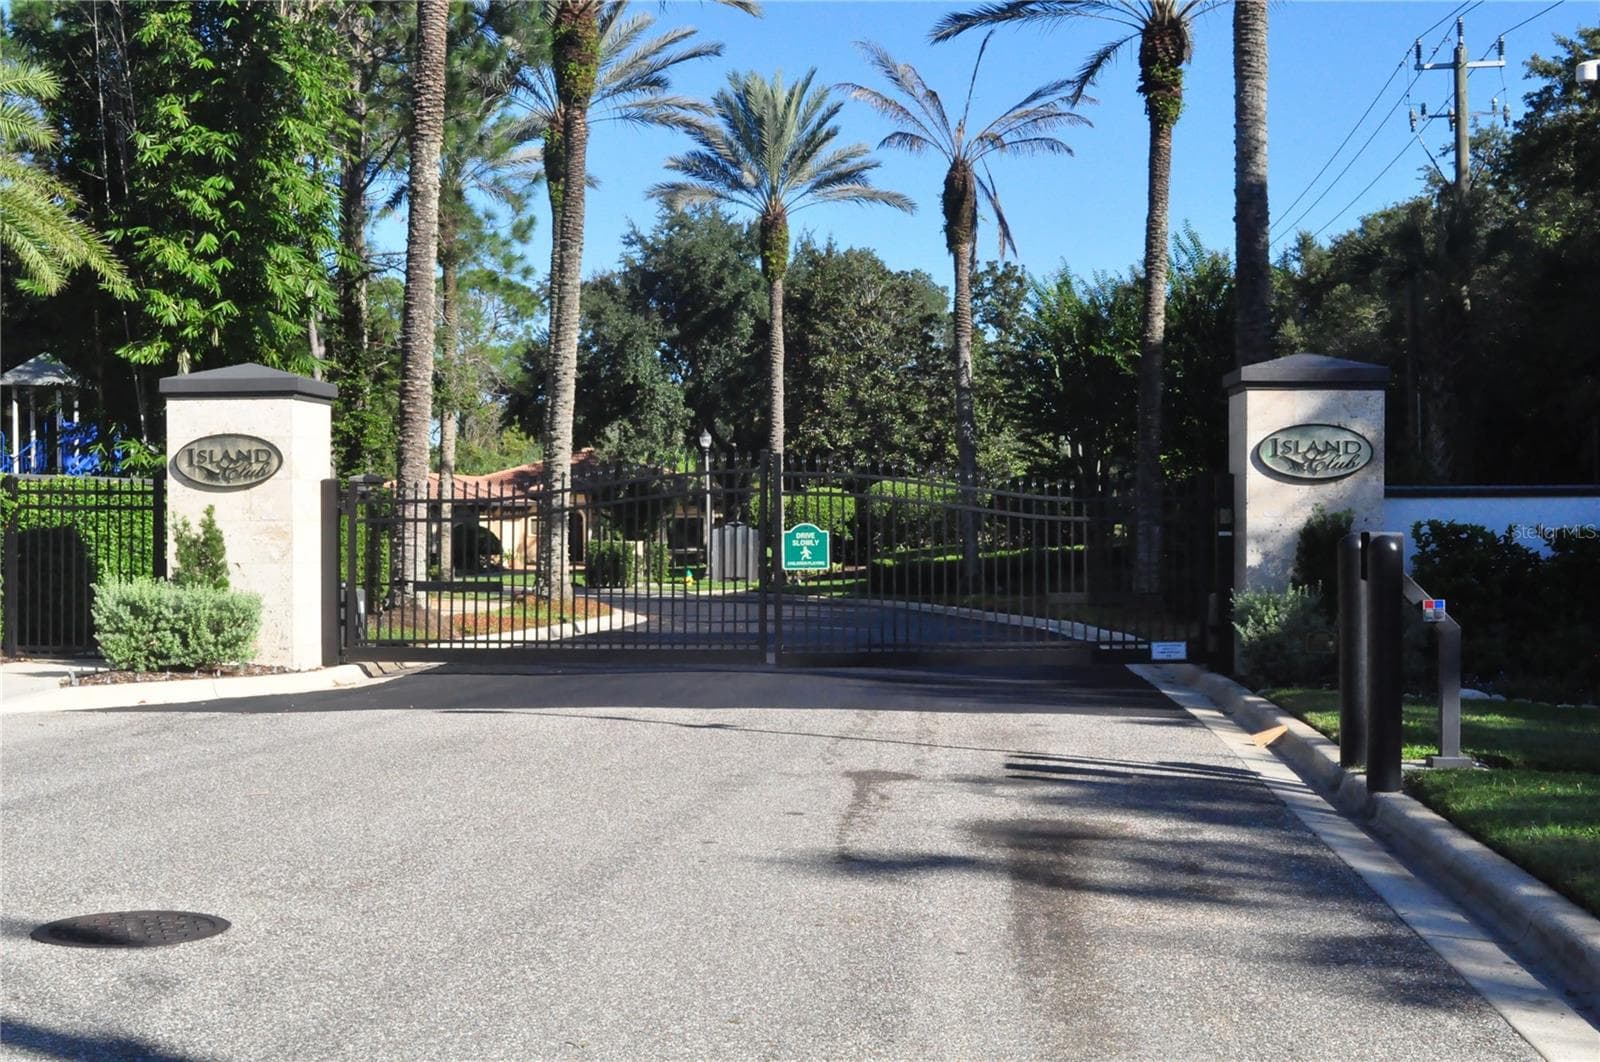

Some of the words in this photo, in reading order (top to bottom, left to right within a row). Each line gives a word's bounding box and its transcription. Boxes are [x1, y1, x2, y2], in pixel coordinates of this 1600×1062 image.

[186, 448, 272, 467] ISLAND
[1269, 438, 1362, 458] ISLAND
[216, 459, 271, 483] Club
[1302, 450, 1361, 475] Club
